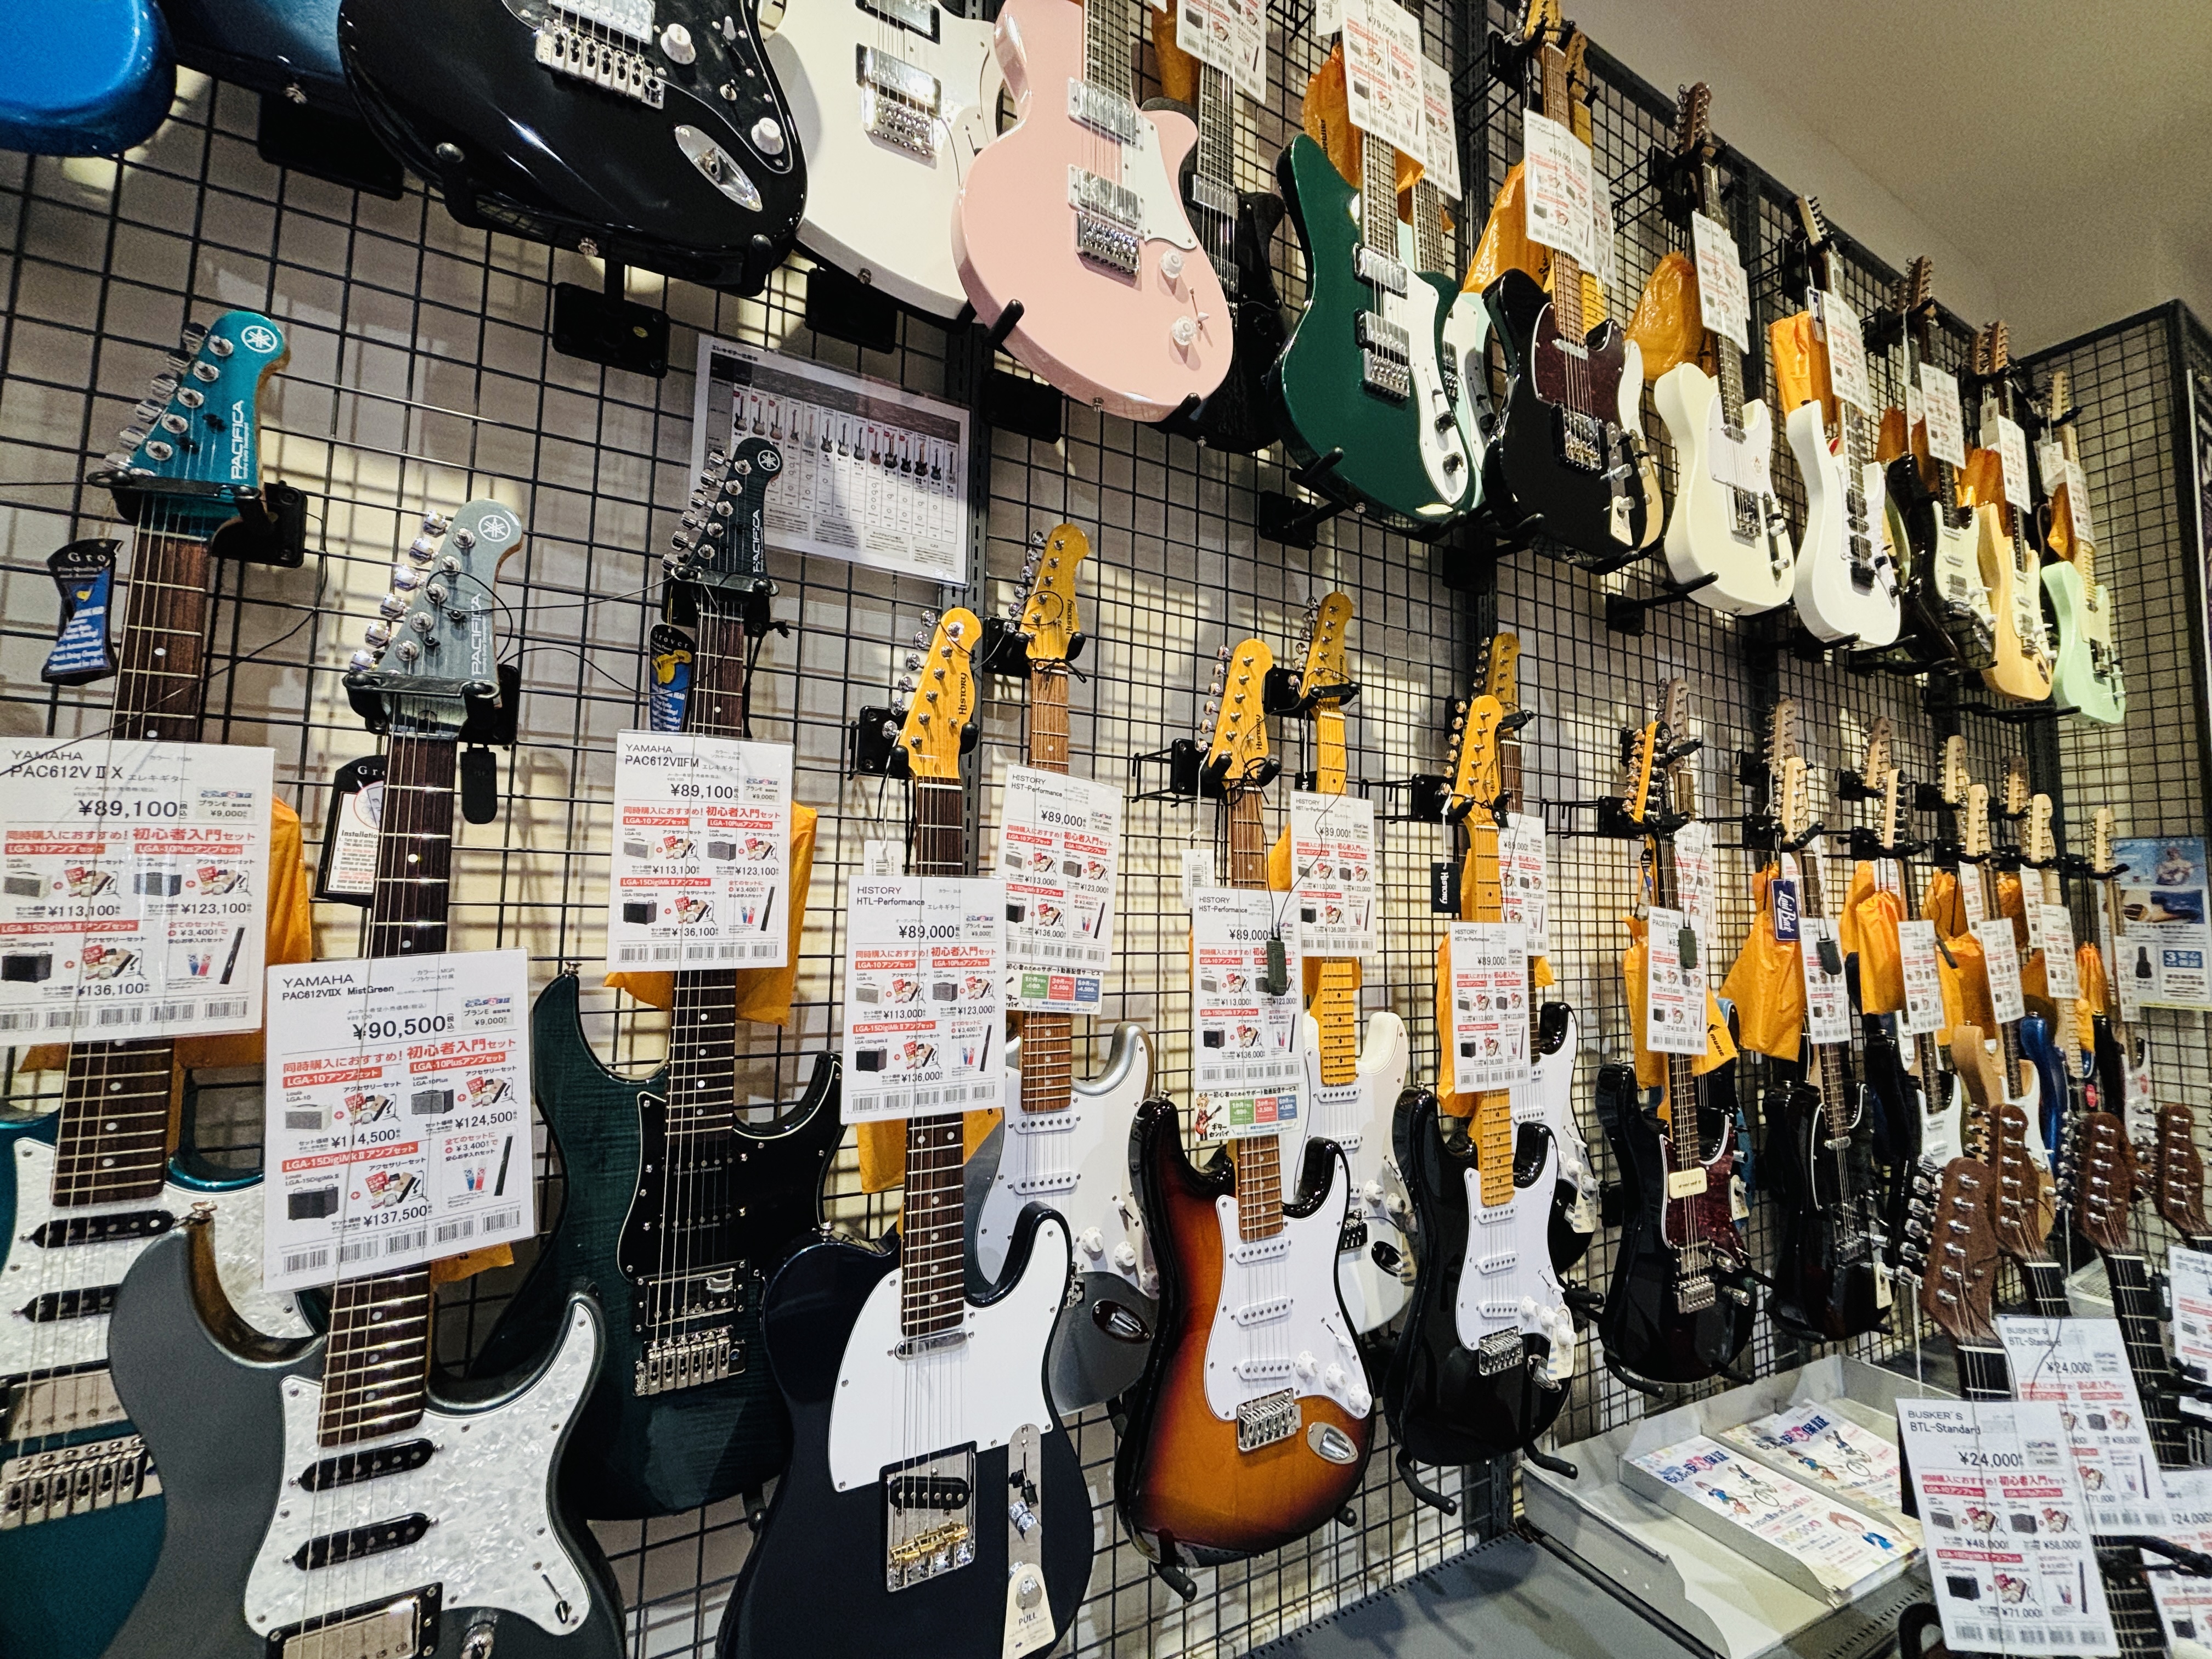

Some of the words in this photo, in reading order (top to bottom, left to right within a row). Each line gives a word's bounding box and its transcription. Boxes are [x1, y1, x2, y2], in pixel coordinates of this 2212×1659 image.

[231, 400, 244, 479] PACIFICA
[471, 593, 481, 675] PACIFICA
[626, 744, 673, 753] YAMAHA
[12, 751, 82, 761] YAMAHA
[1012, 774, 1046, 785] HISTORY
[671, 784, 733, 799] ¥89,100
[1011, 782, 1062, 797] HST-Performance
[79, 800, 177, 817] ¥89,100
[624, 806, 703, 815] 同時購入におすすめ!
[707, 806, 780, 819] 初心者入門セット
[1041, 810, 1082, 827] ¥89,000
[133, 828, 256, 841] 初心者入門セット
[1319, 827, 1348, 838] ¥89,000
[1064, 832, 1112, 847] 初心者入門セット
[653, 866, 696, 874] ¥113,100
[735, 867, 776, 876] ¥123,100
[1081, 883, 1107, 893] ¥123,000
[857, 897, 925, 905] HTL-Performance
[49, 906, 115, 916] ¥113,100
[181, 904, 246, 914] ¥123,100
[899, 926, 955, 940] ¥89,000
[1035, 929, 1064, 938] ¥136,000
[1229, 929, 1268, 941] ¥89,000
[931, 946, 996, 956] 初心者入門セット
[1477, 957, 1504, 967] ¥89,000
[283, 974, 353, 988] YAMAHA
[884, 1009, 923, 1019] ¥113,000
[958, 1005, 992, 1014] ¥123,000
[353, 1015, 445, 1040] ¥90,500
[1709, 1034, 1724, 1057] music
[283, 1053, 403, 1073] 同時購入におすすめ!
[407, 1038, 516, 1059] 初心者入門セット
[465, 1065, 517, 1076] アクセサリーセット
[902, 1071, 940, 1082] ¥136,000
[343, 1081, 401, 1092] アクセサリーセット
[455, 1111, 512, 1128] ¥124,500
[445, 1132, 495, 1144] 全てのセットに
[369, 1158, 426, 1171] アクセサリーセット
[363, 1205, 427, 1227] ¥137,500
[2045, 1361, 2089, 1374] ¥24,000
[1911, 1422, 1981, 1435] BTL-Standard
[1958, 1452, 2019, 1468] ¥24,000
[1966, 1538, 2007, 1550] ¥48,000
[1018, 1612, 1037, 1626] PULL
